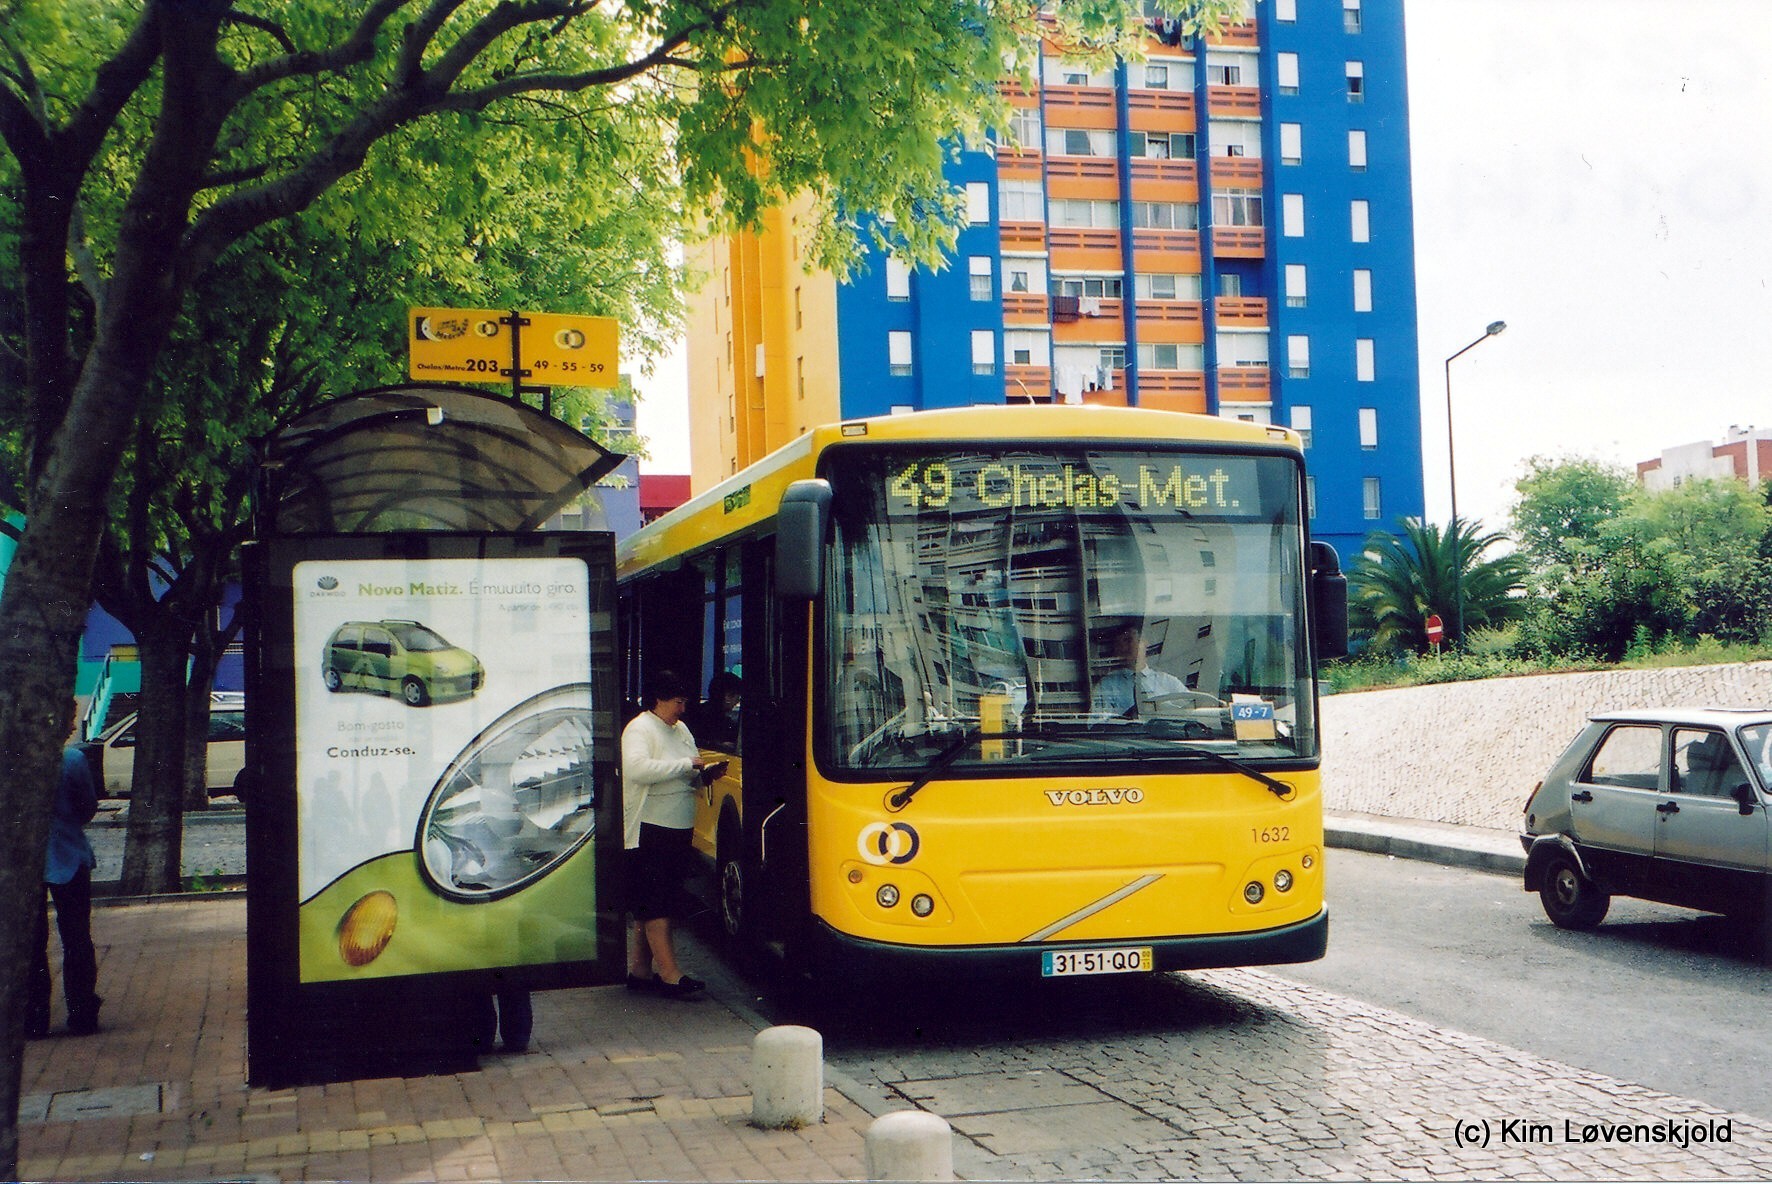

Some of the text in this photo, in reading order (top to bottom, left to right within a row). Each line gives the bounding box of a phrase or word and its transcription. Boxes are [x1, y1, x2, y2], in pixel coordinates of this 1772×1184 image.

[466, 359, 498, 372] 203
[534, 360, 549, 370] 49
[562, 361, 577, 372] 55
[590, 363, 604, 373] 59
[891, 463, 1239, 507] 49 Chelas-Met.
[358, 580, 577, 598] Novo Matiz. É muuuito giro.
[337, 720, 404, 734] Bom-gosto
[326, 745, 416, 758] Conduz-se.
[1044, 787, 1144, 806] VOLVO
[1251, 826, 1290, 844] 1632
